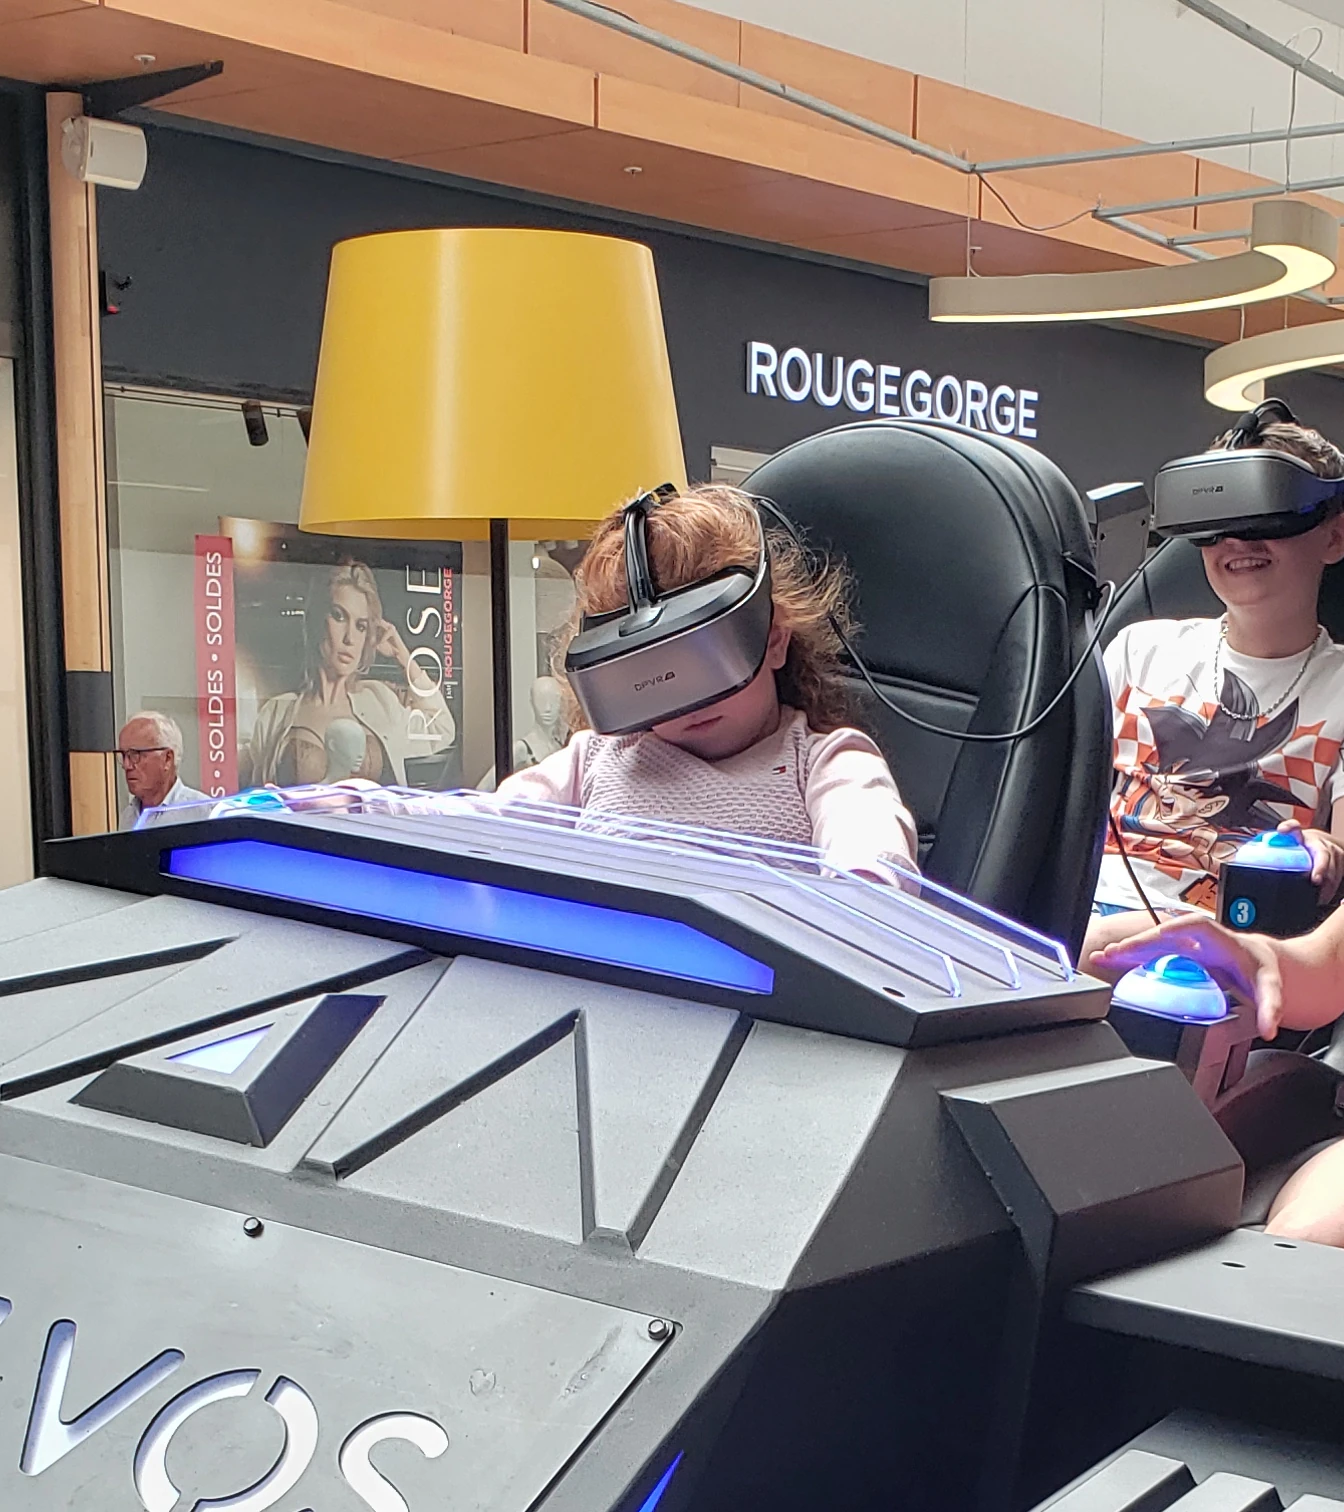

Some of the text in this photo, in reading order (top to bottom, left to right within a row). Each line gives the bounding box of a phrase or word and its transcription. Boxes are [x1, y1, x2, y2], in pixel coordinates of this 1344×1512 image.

[746, 341, 1040, 439] ROUGEGORGE
[206, 551, 225, 762] SOLDES SOLDES
[405, 564, 444, 741] ROSE
[443, 567, 453, 678] ROUGEGORGE
[1236, 902, 1250, 924] 3
